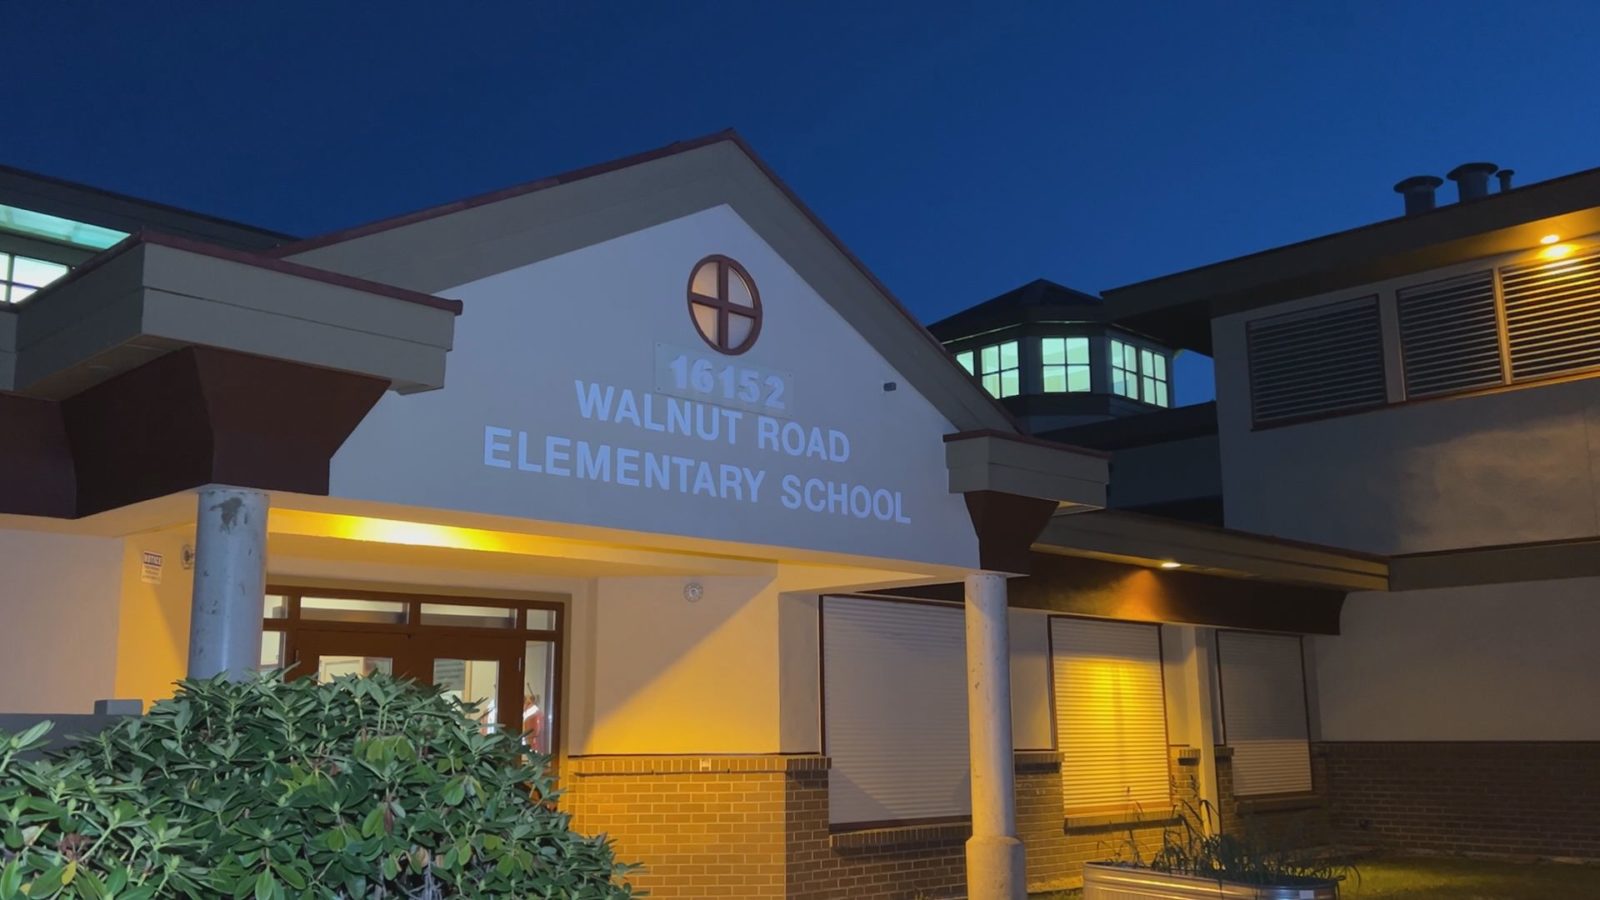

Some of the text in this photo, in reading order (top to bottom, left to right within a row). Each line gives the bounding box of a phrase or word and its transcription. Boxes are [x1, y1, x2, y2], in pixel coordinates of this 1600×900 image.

[575, 380, 850, 464] WALNUT ROAD
[670, 355, 785, 409] 16152
[483, 425, 911, 524] ELEMENTARY SCHOOL
